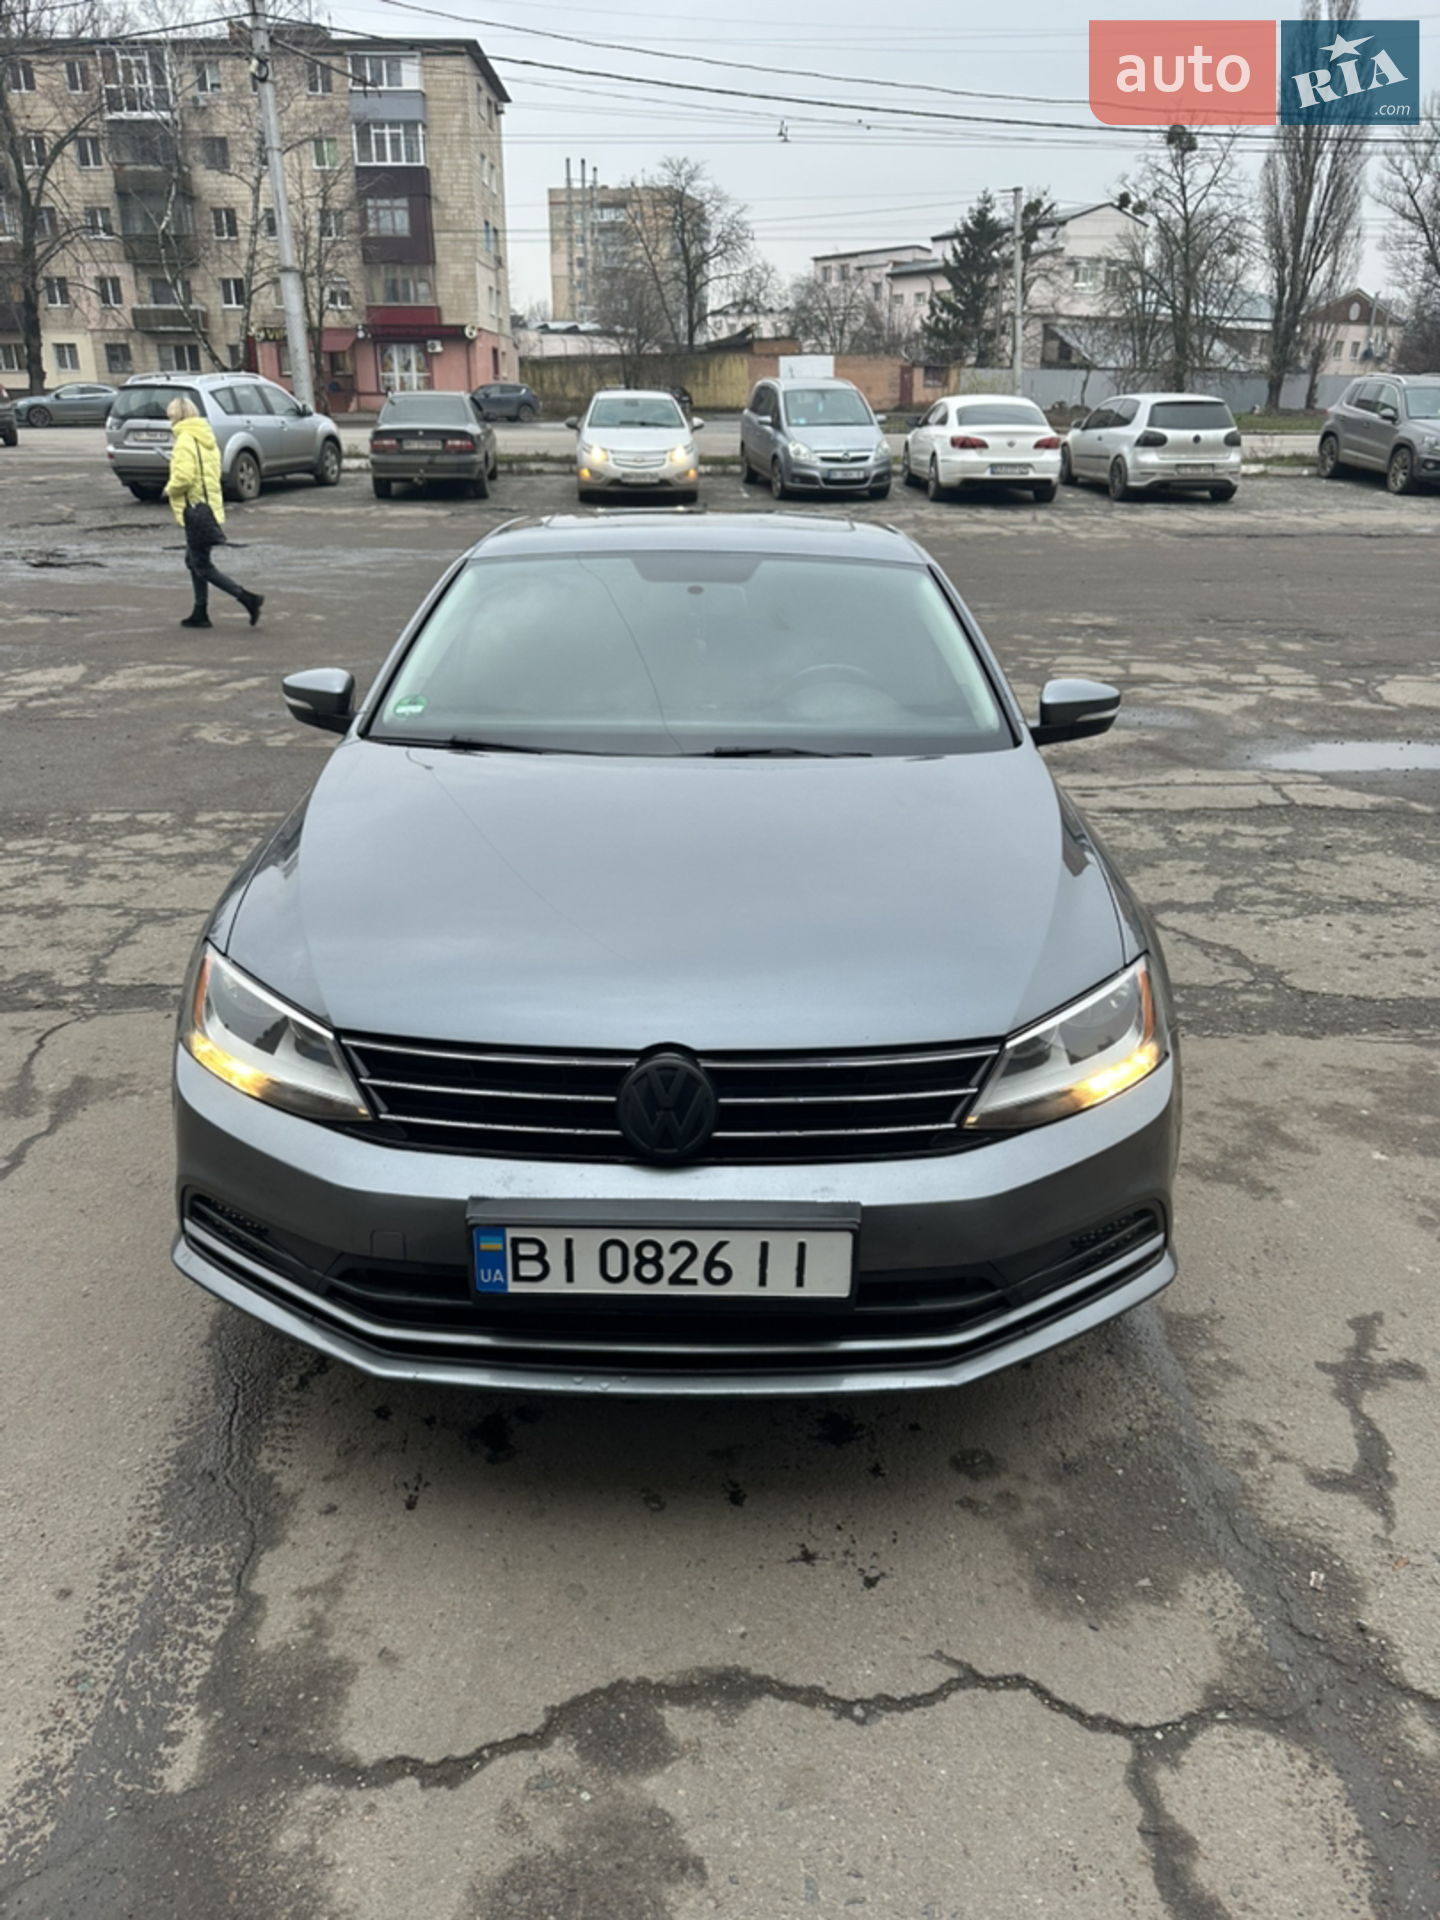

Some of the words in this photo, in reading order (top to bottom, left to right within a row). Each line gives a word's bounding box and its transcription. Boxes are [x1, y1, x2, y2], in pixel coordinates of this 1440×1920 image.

[480, 1268, 505, 1284] UA
[510, 1236, 575, 1283] BI
[599, 1238, 733, 1287] 0826
